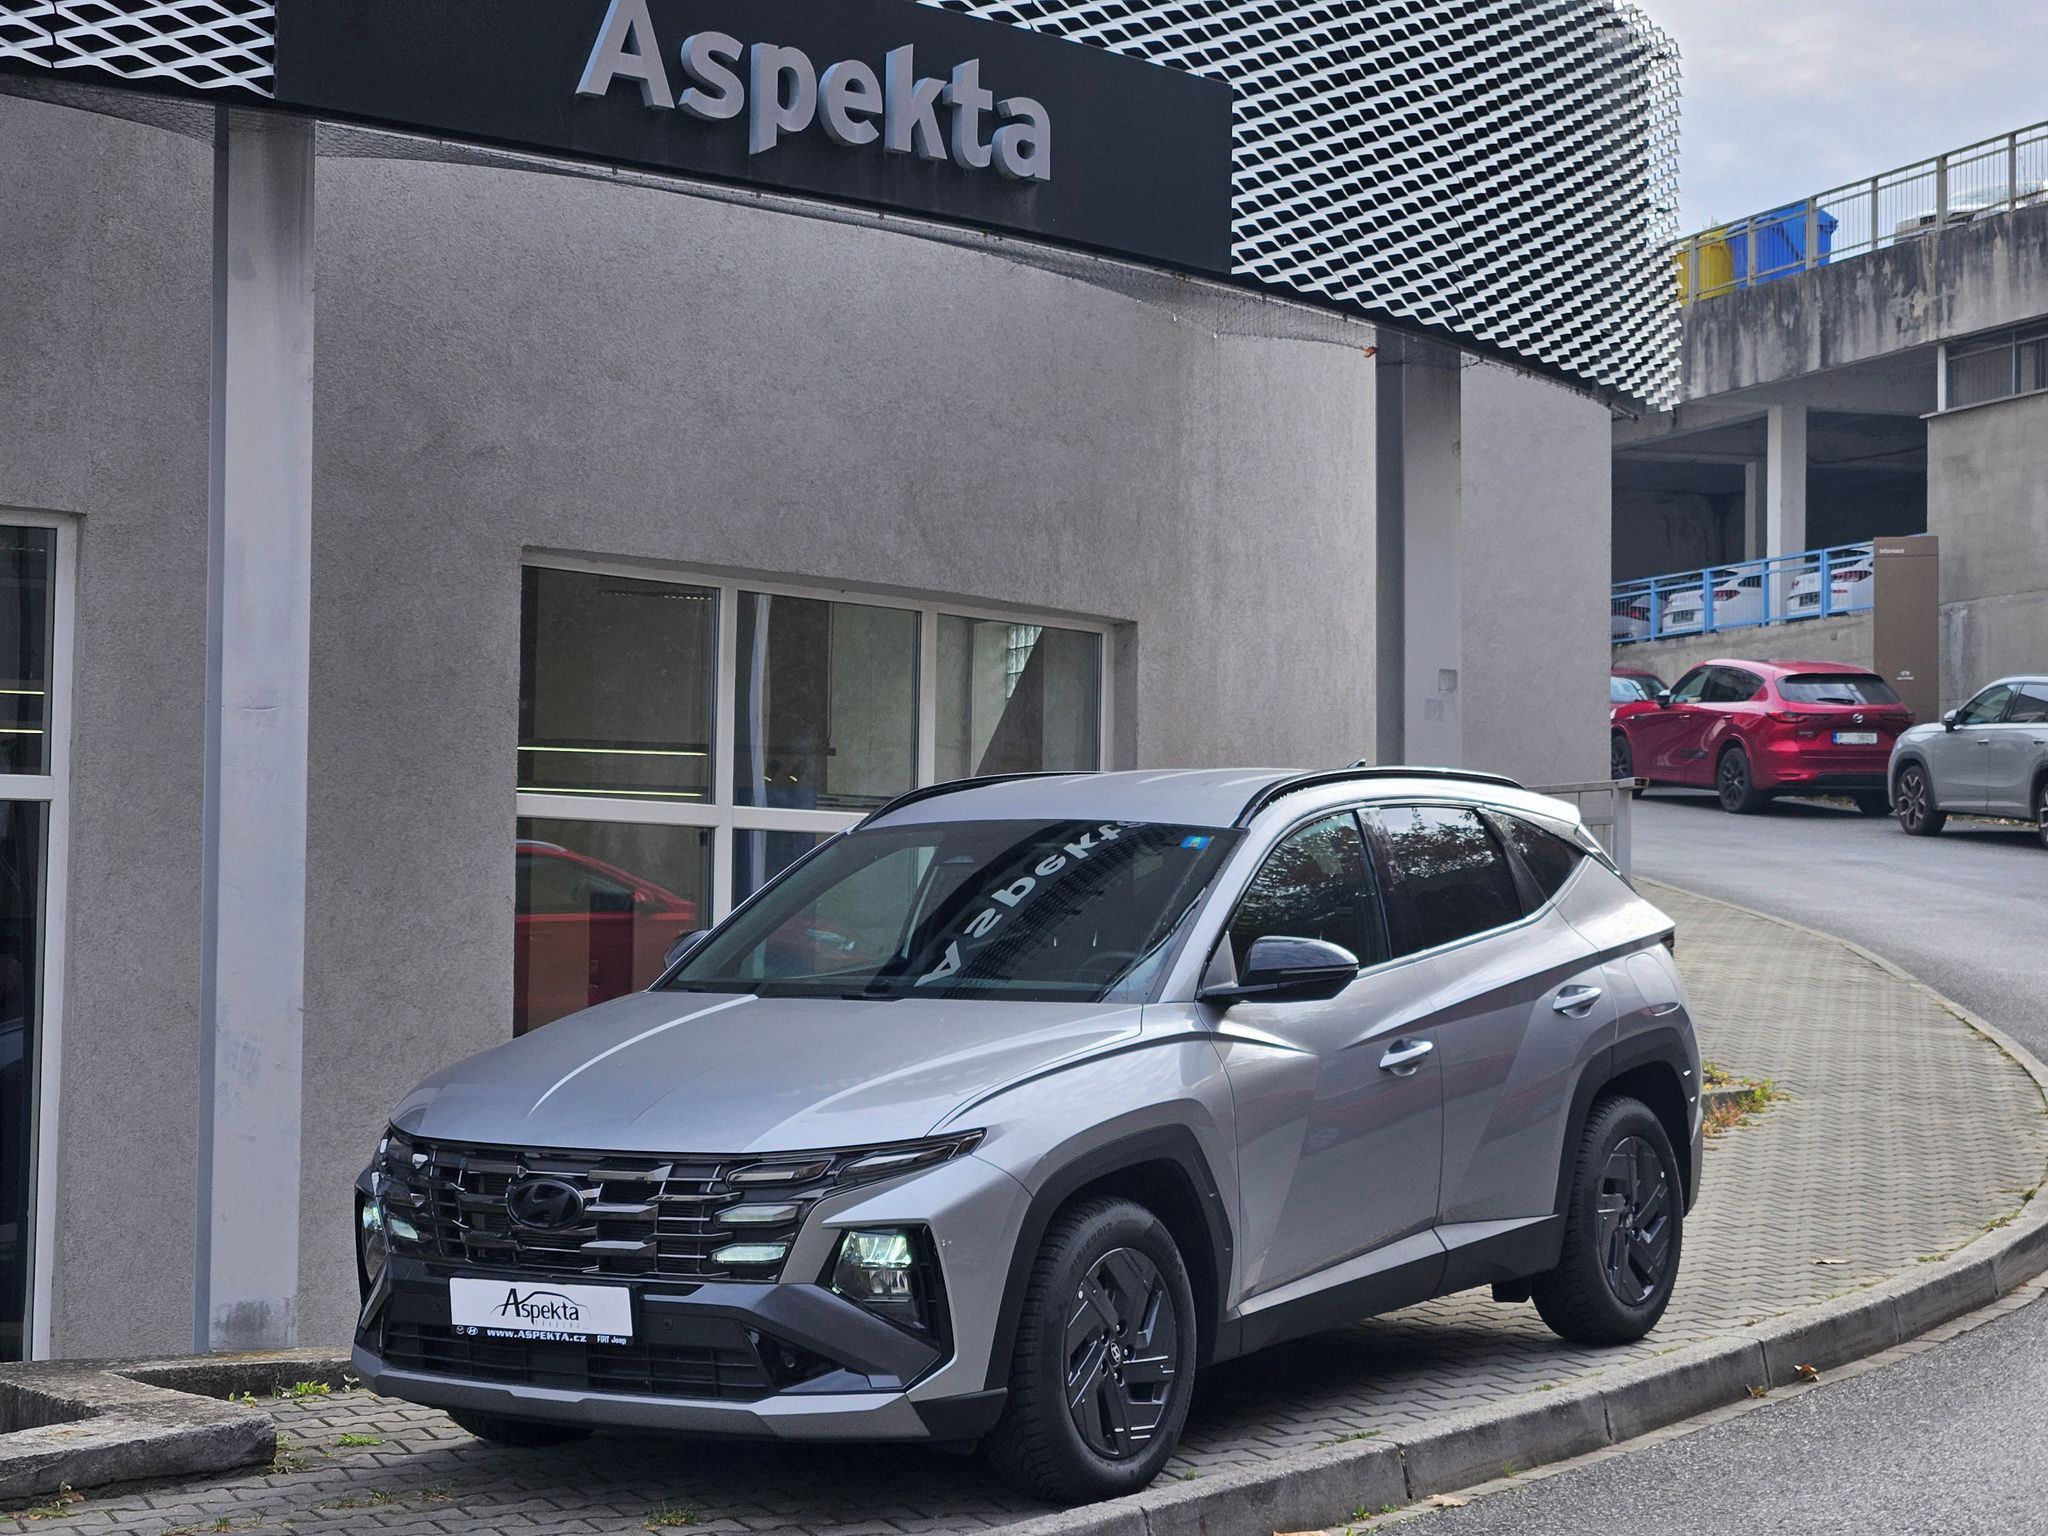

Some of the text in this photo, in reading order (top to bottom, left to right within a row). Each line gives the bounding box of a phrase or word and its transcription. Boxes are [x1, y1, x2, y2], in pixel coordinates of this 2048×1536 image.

[575, 0, 1051, 181] Aspekta
[501, 1288, 579, 1325] Aspekta
[597, 1335, 610, 1344] FIAT
[611, 1336, 627, 1346] Jeep
